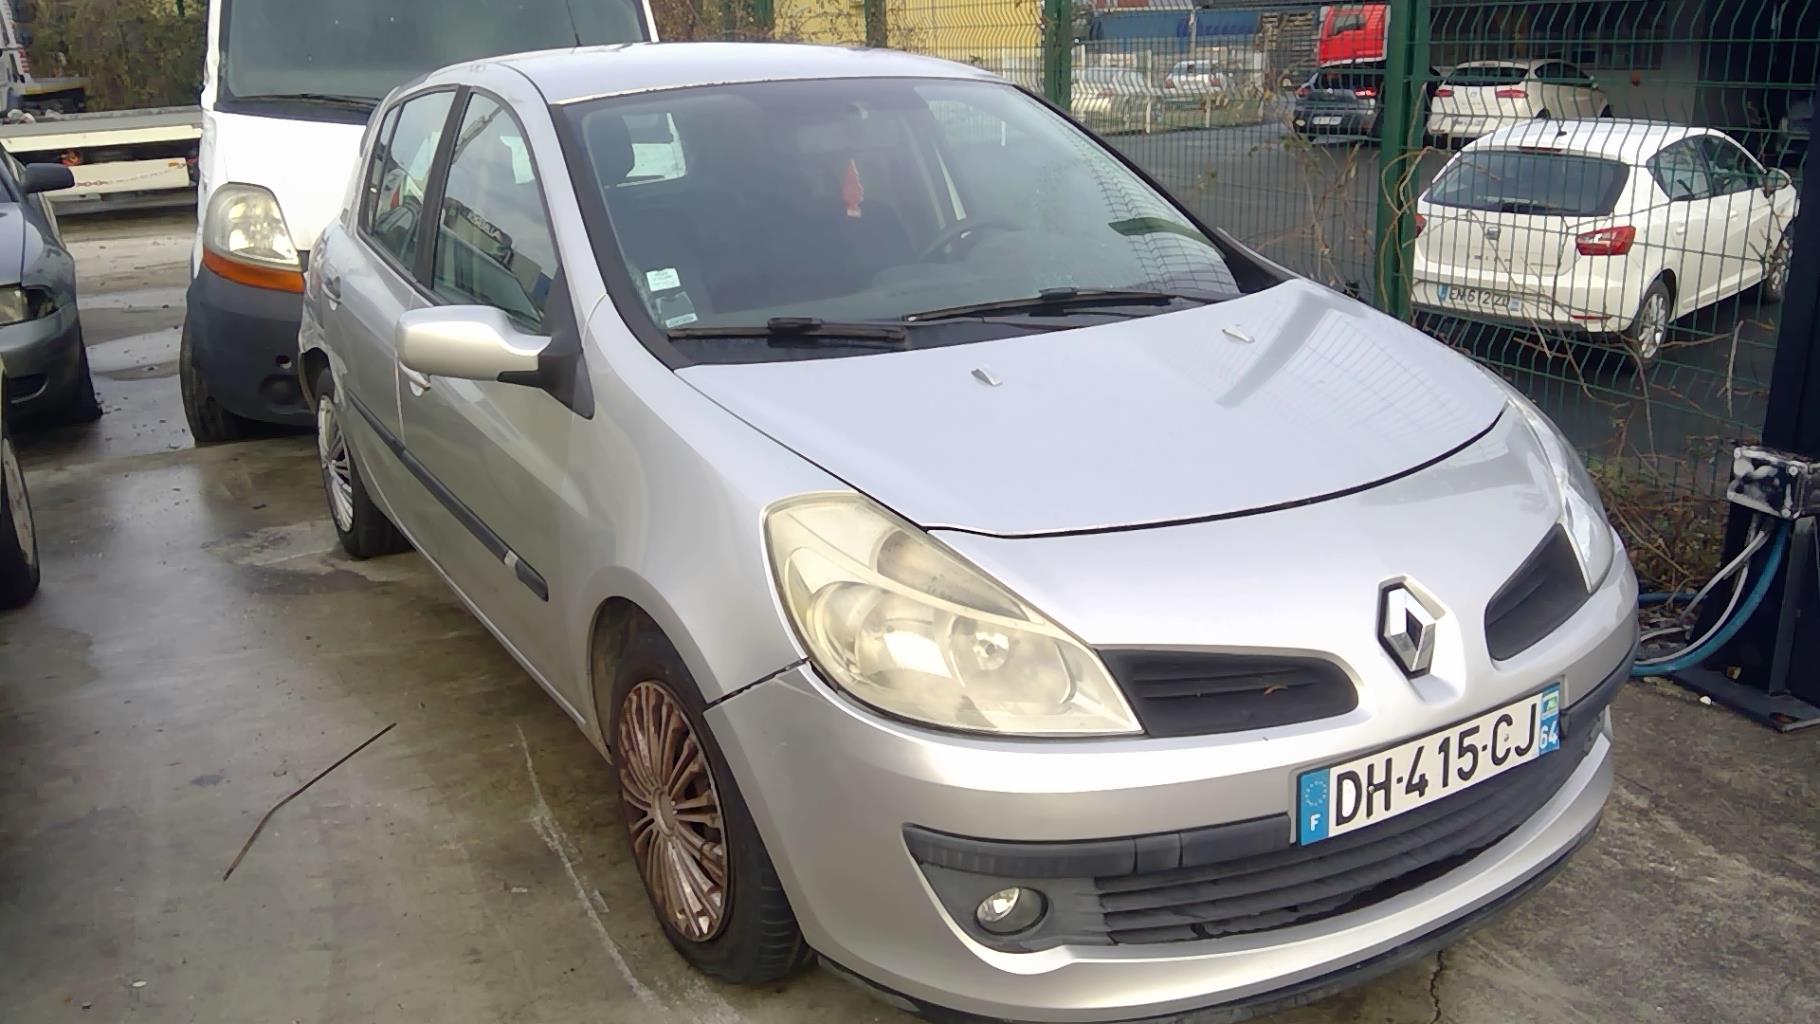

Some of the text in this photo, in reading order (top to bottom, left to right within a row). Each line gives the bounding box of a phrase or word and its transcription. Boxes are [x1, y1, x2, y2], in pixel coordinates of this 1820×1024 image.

[1310, 703, 1558, 832] F DH-415-CJ 64
